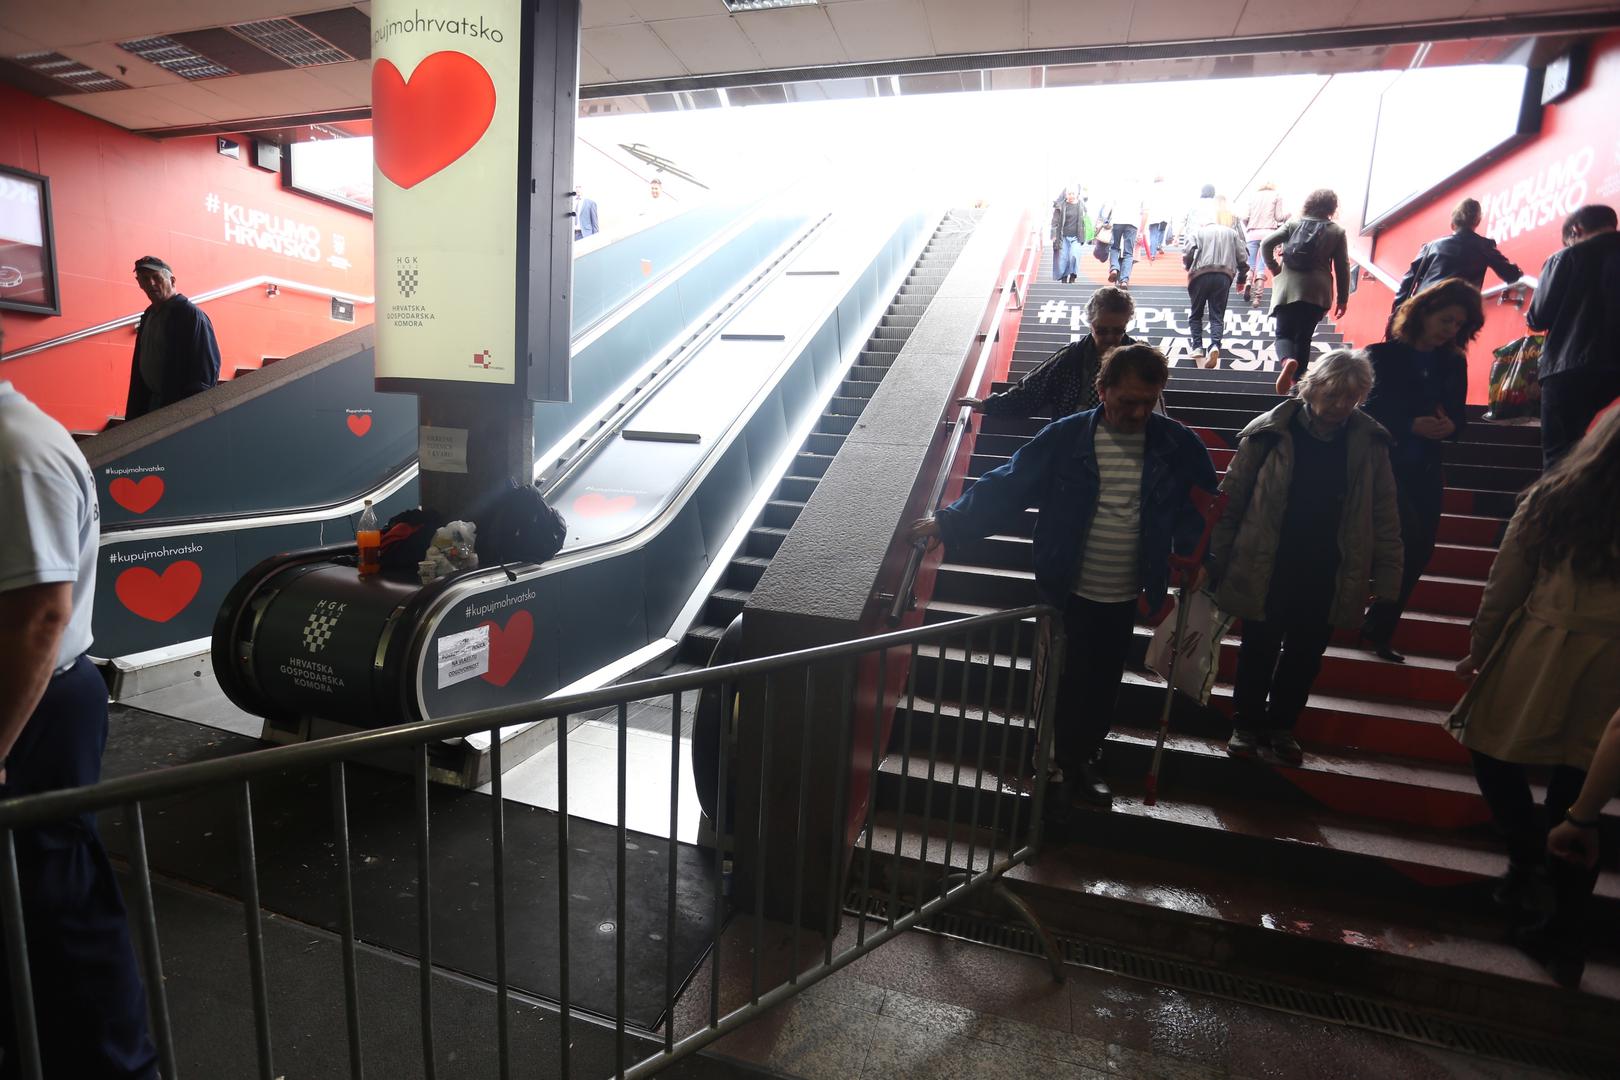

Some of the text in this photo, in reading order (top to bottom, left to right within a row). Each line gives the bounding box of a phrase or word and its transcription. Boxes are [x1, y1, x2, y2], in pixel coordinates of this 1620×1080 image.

[224, 221, 321, 263] HRVATSKO
[105, 464, 166, 476] #kupujmohrvatsko
[108, 542, 203, 564] #kupujmohrvatsko
[465, 587, 537, 618] #kupujmohrvatsko
[280, 665, 346, 688] GOSPODARSKA
[289, 656, 334, 675] HRVATSKA
